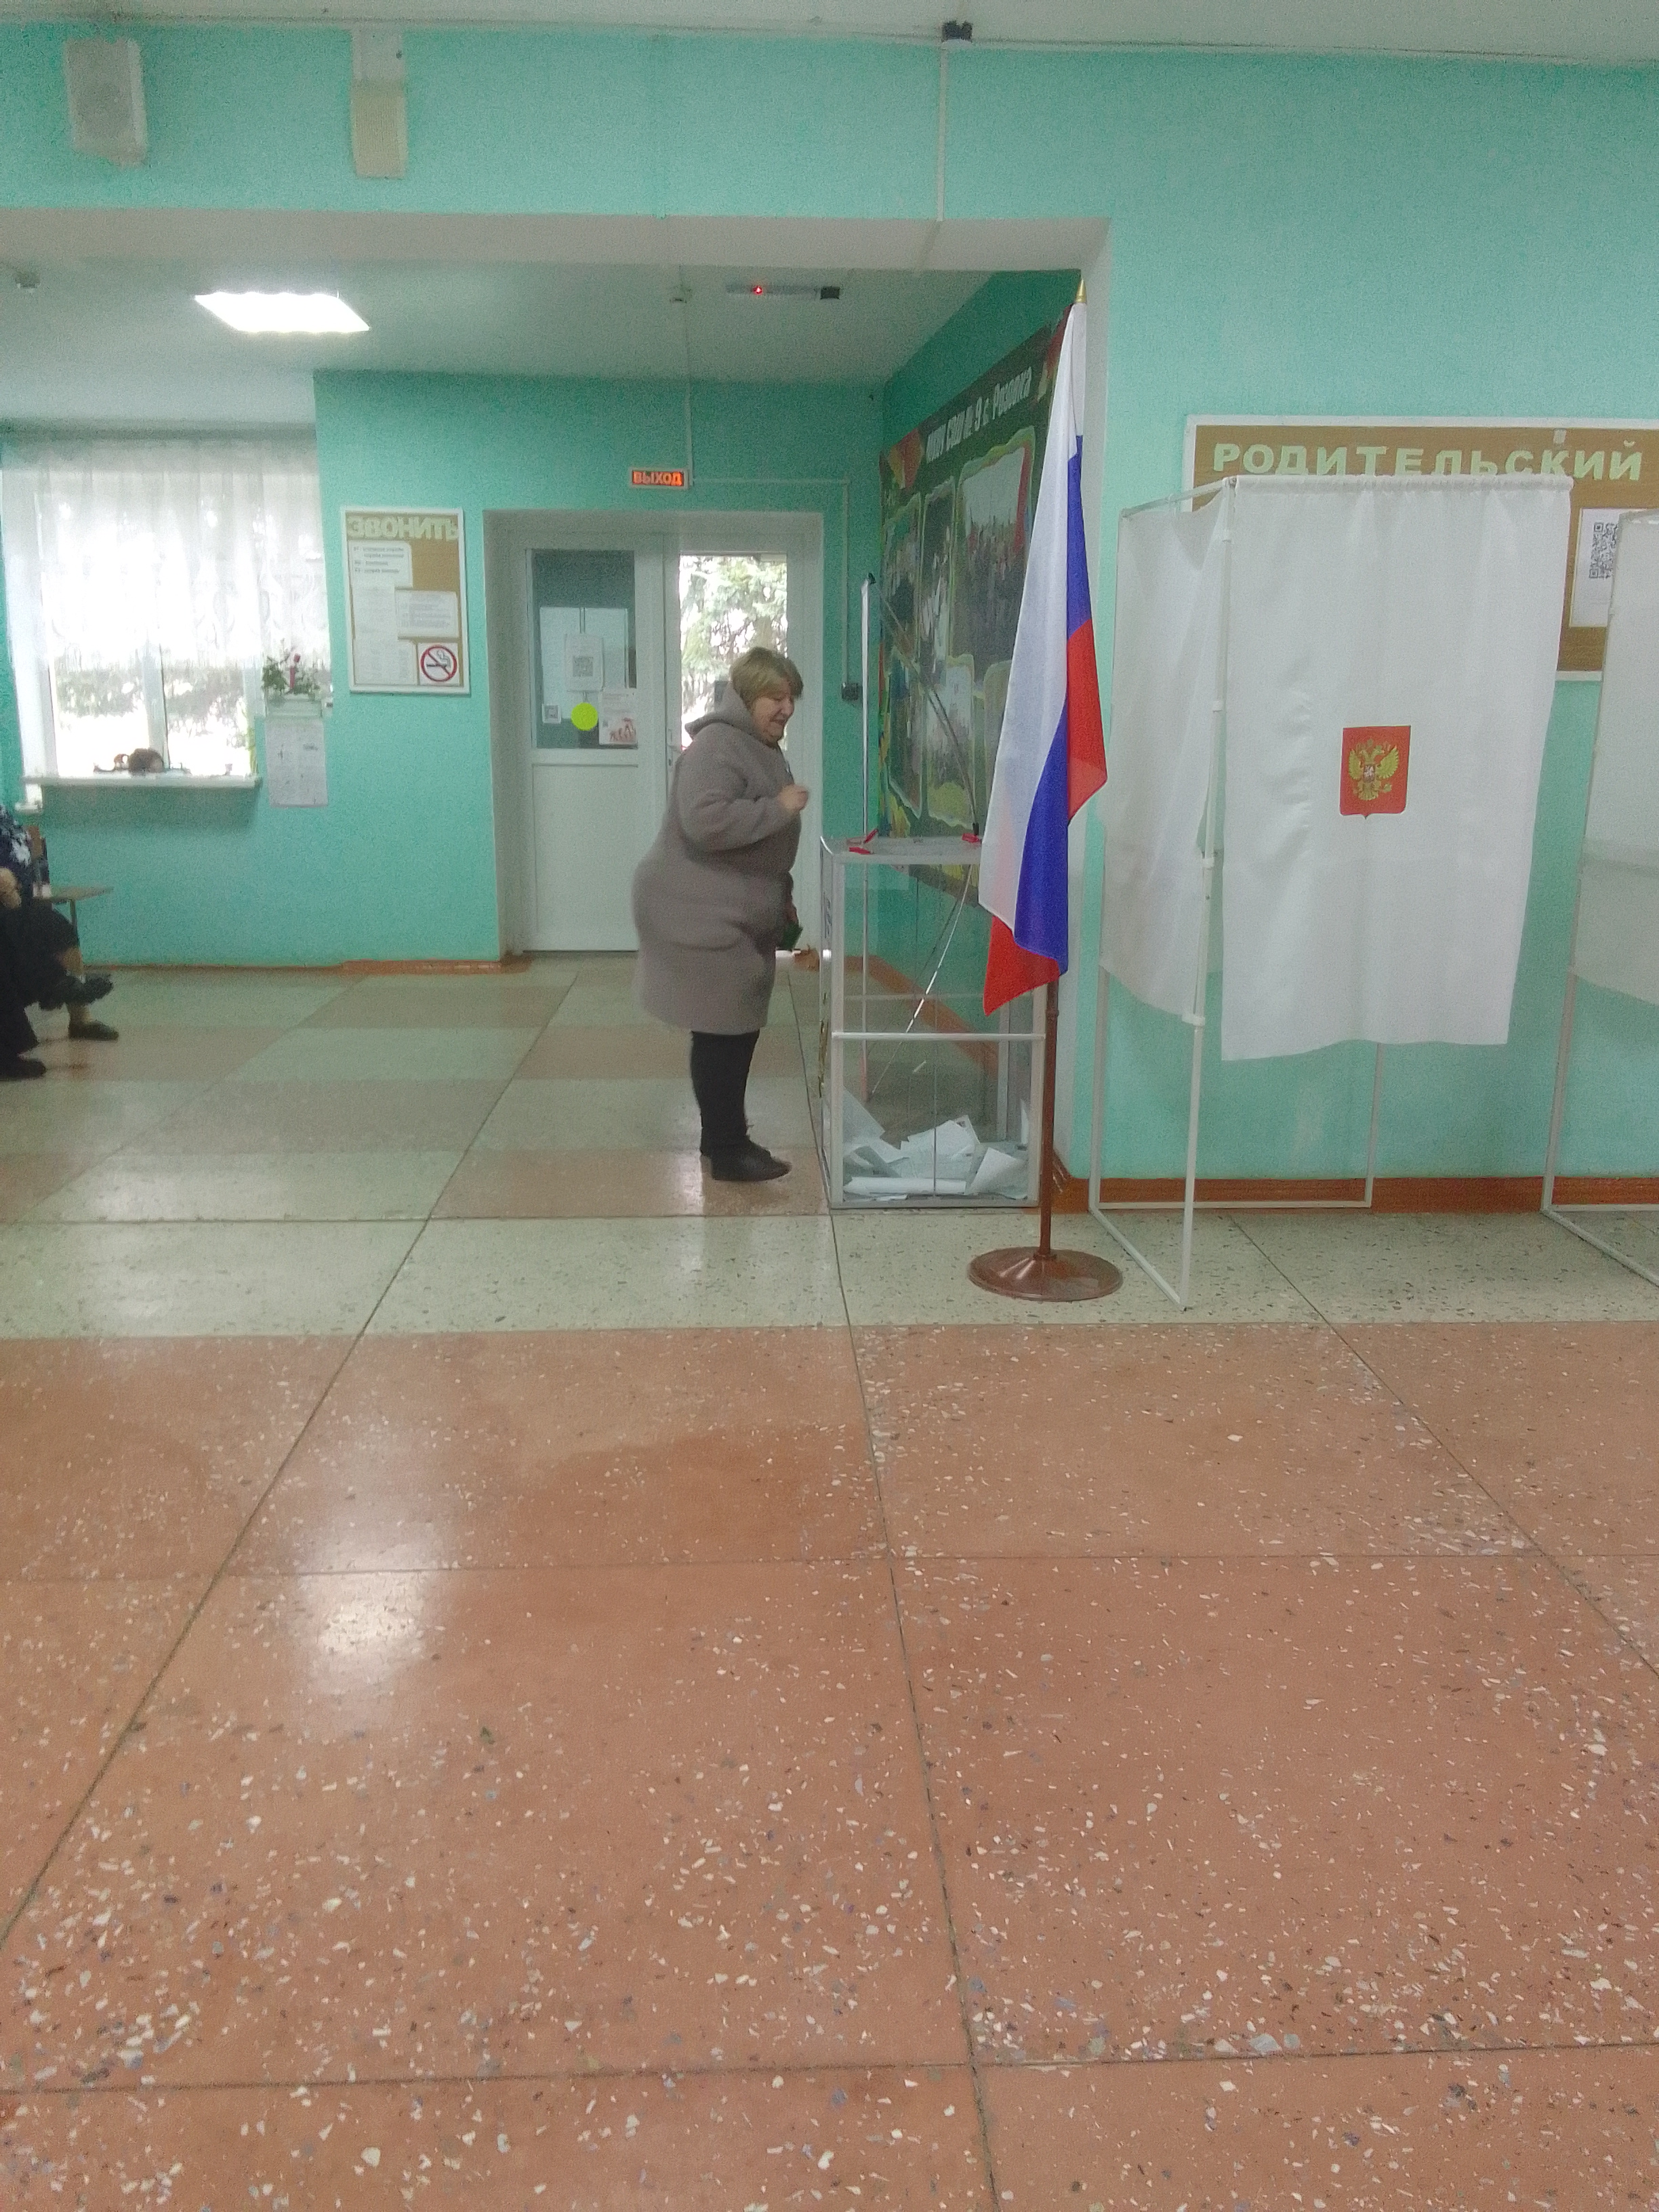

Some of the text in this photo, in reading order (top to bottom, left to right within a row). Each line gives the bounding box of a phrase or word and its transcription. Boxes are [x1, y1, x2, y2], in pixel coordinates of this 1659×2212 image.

[1213, 439, 1643, 480] РОДИТЕЛЬСКИЙ
[633, 471, 682, 486] ВЫХОД
[346, 516, 459, 541] ЗВОНИТЬ
